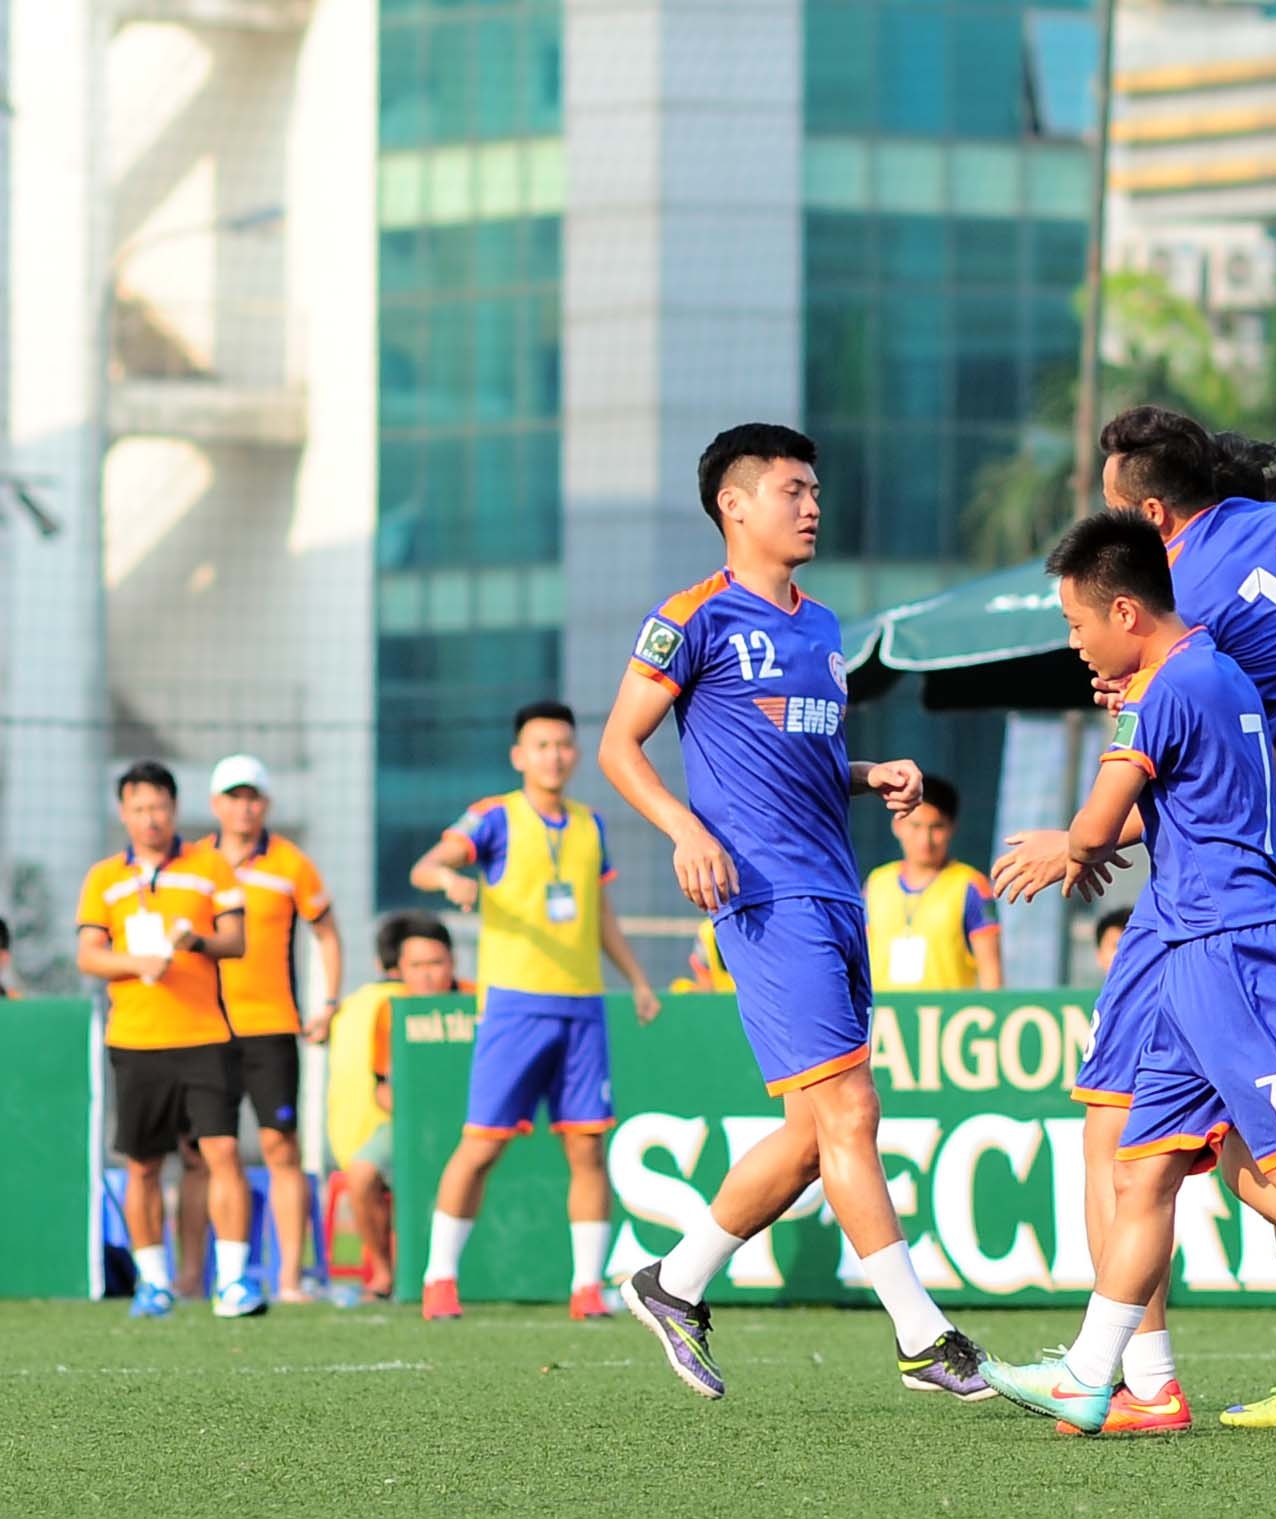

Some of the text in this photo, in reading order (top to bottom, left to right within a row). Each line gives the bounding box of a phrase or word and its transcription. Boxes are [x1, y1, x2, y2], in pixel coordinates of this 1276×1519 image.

[728, 630, 784, 681] 12
[786, 696, 840, 737] EMS
[1239, 713, 1274, 855] 7
